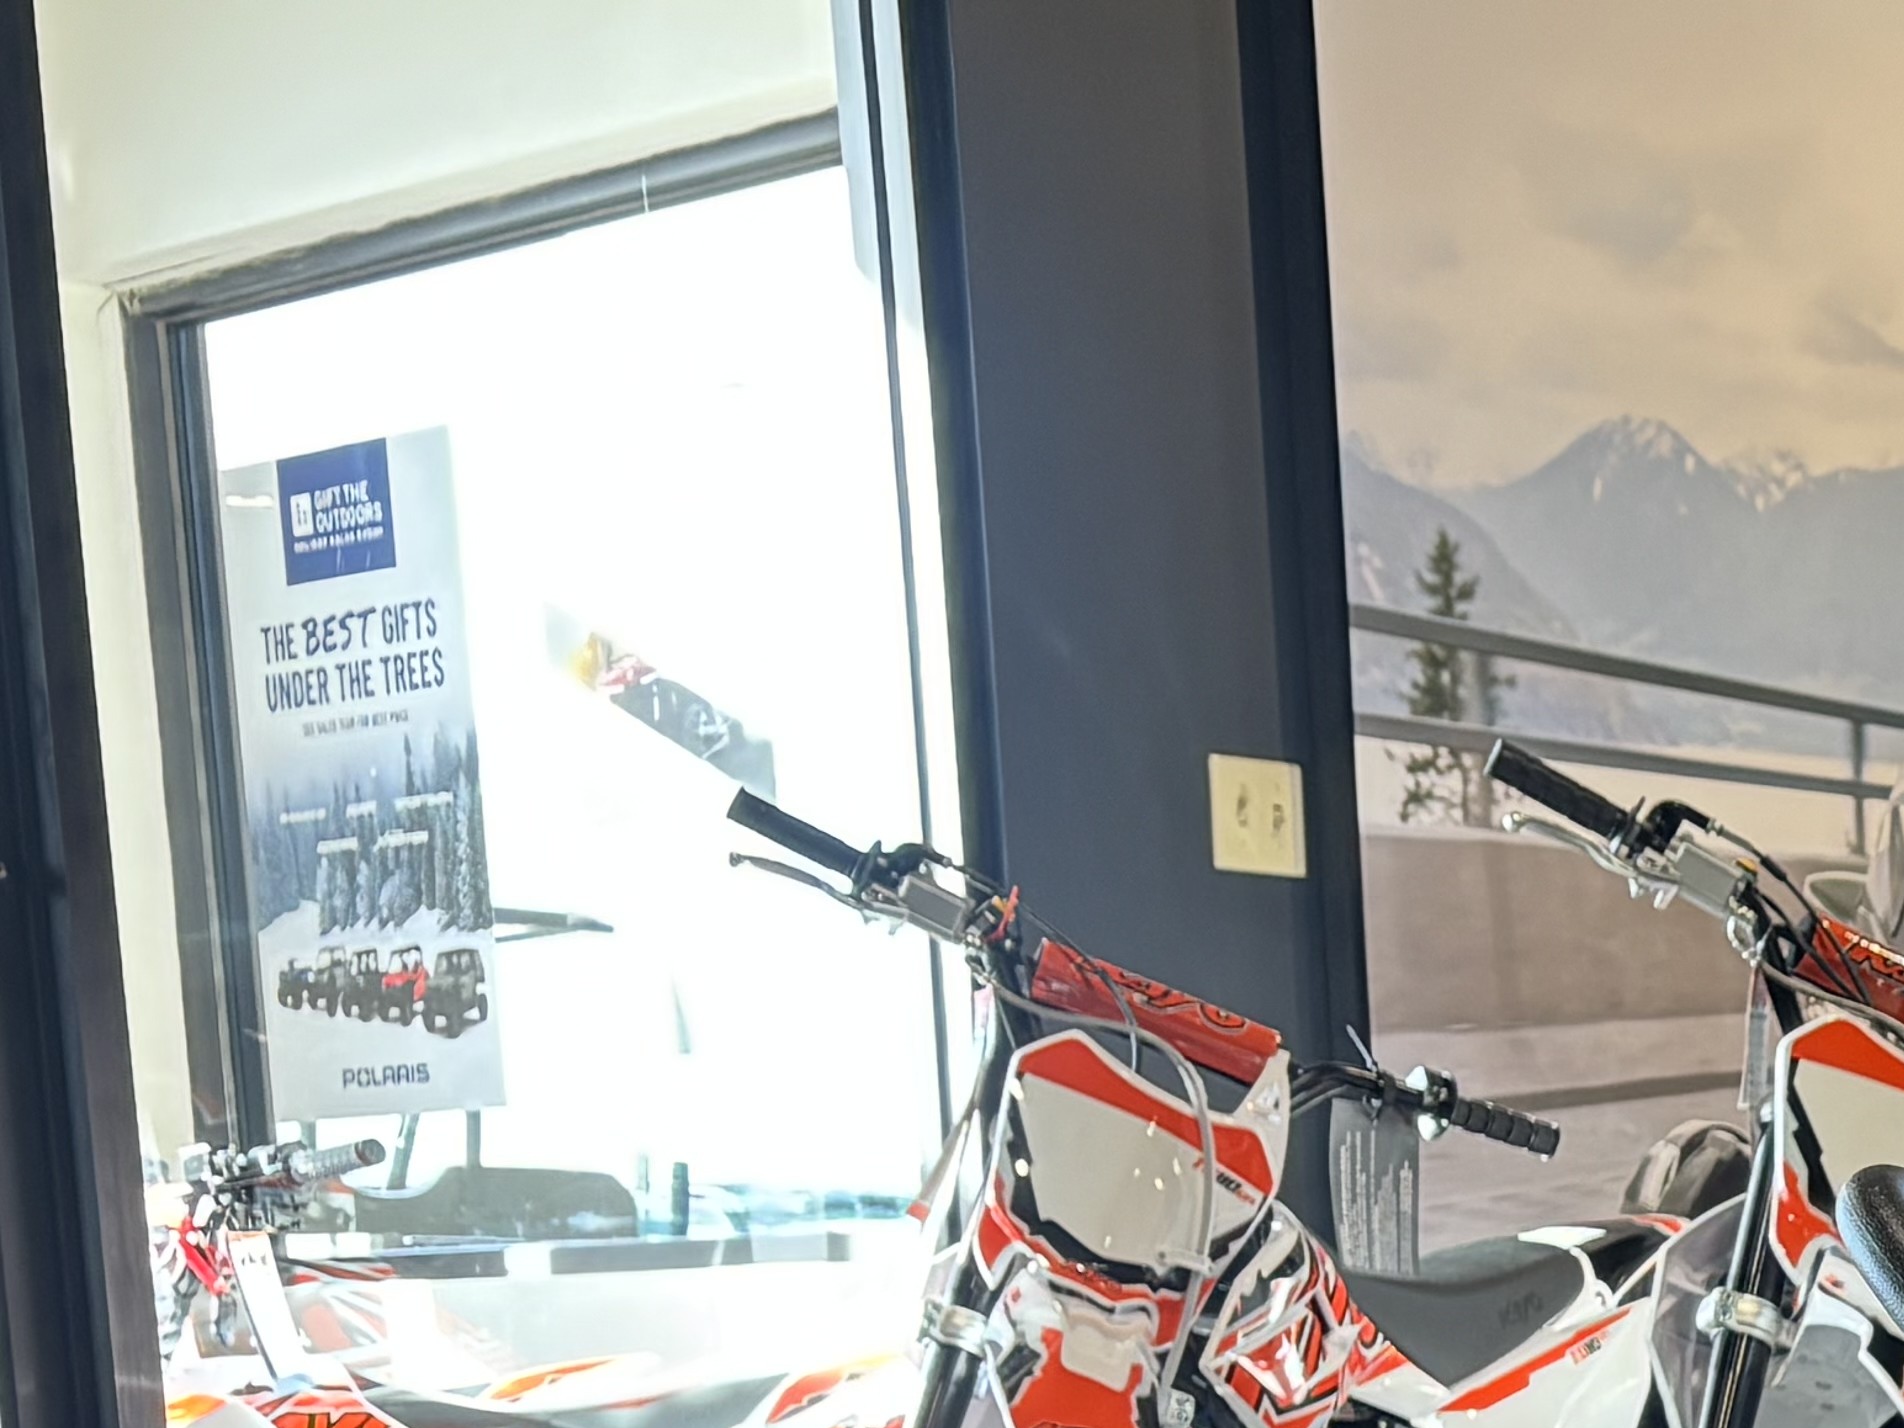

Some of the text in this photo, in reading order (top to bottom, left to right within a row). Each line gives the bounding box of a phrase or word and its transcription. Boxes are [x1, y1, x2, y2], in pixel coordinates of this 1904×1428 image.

[260, 598, 437, 665] THE BEST GIFTS
[265, 646, 445, 713] UNDER THE TREES
[342, 1062, 430, 1089] POLARIS
